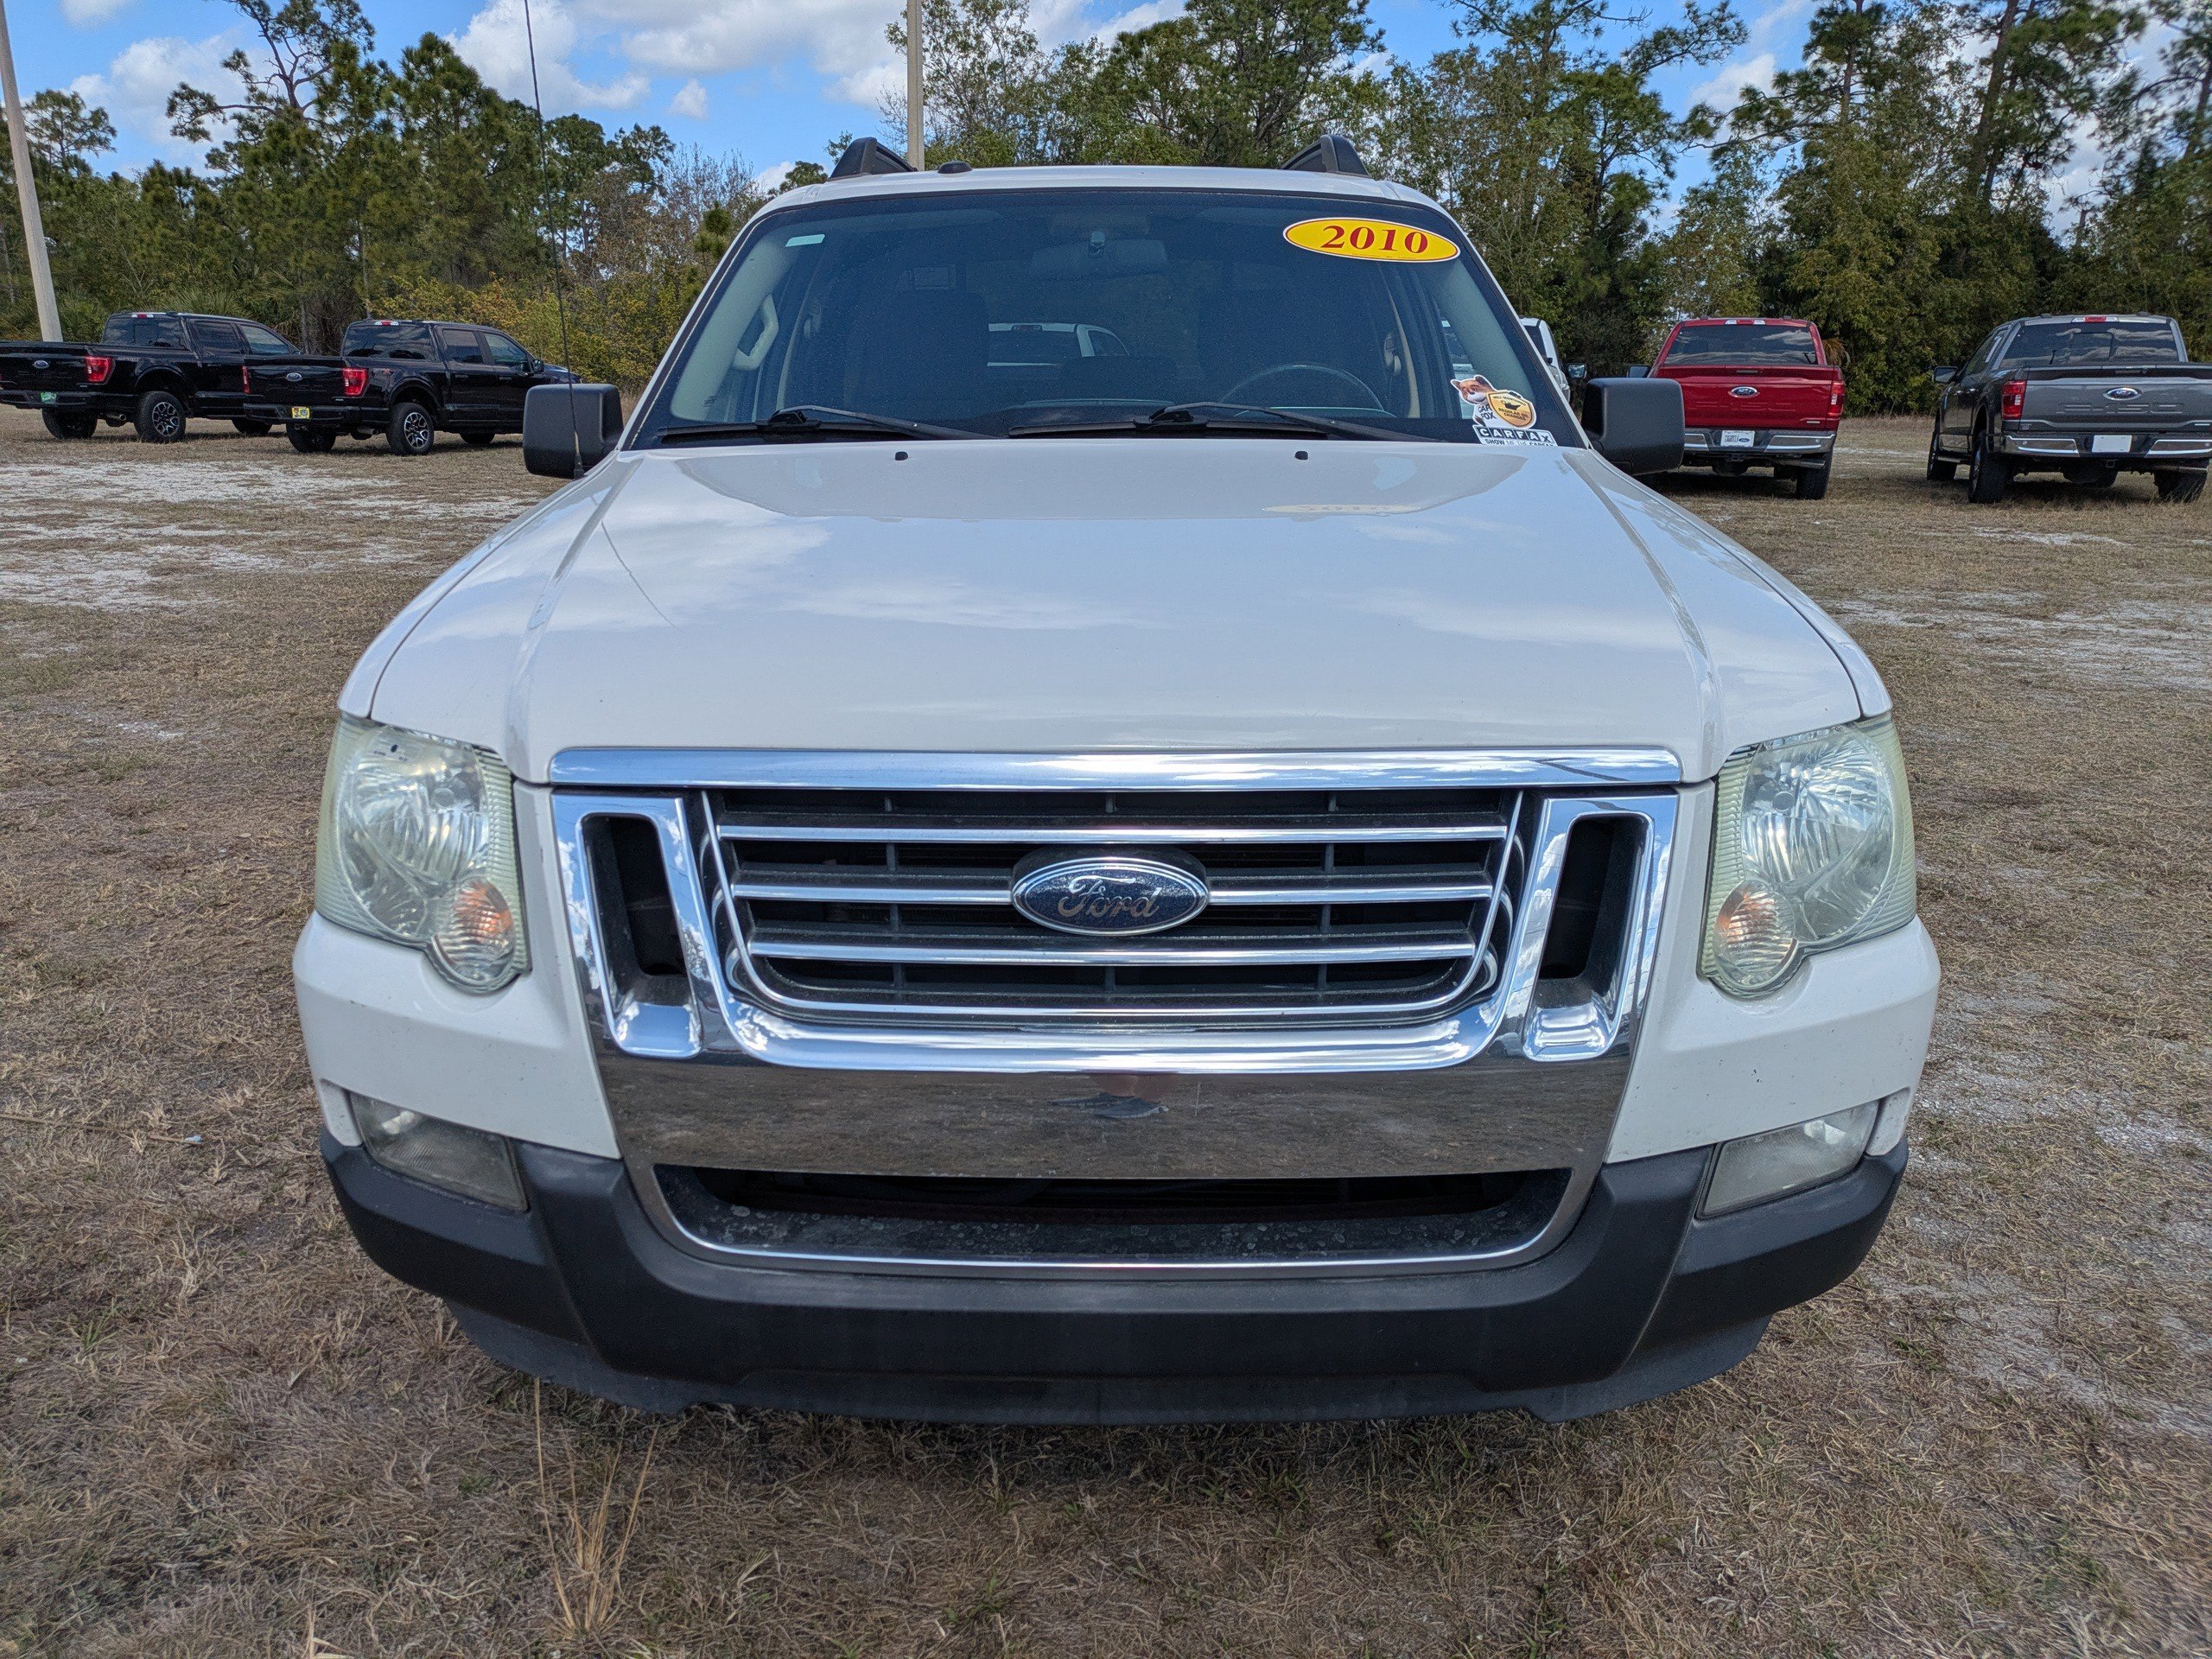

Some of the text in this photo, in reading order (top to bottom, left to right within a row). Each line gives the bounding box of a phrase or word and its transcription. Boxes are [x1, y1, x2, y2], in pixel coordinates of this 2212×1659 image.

[1320, 225, 1428, 254] 2010
[1479, 428, 1551, 443] CARFAX
[1058, 874, 1160, 918] Ford
